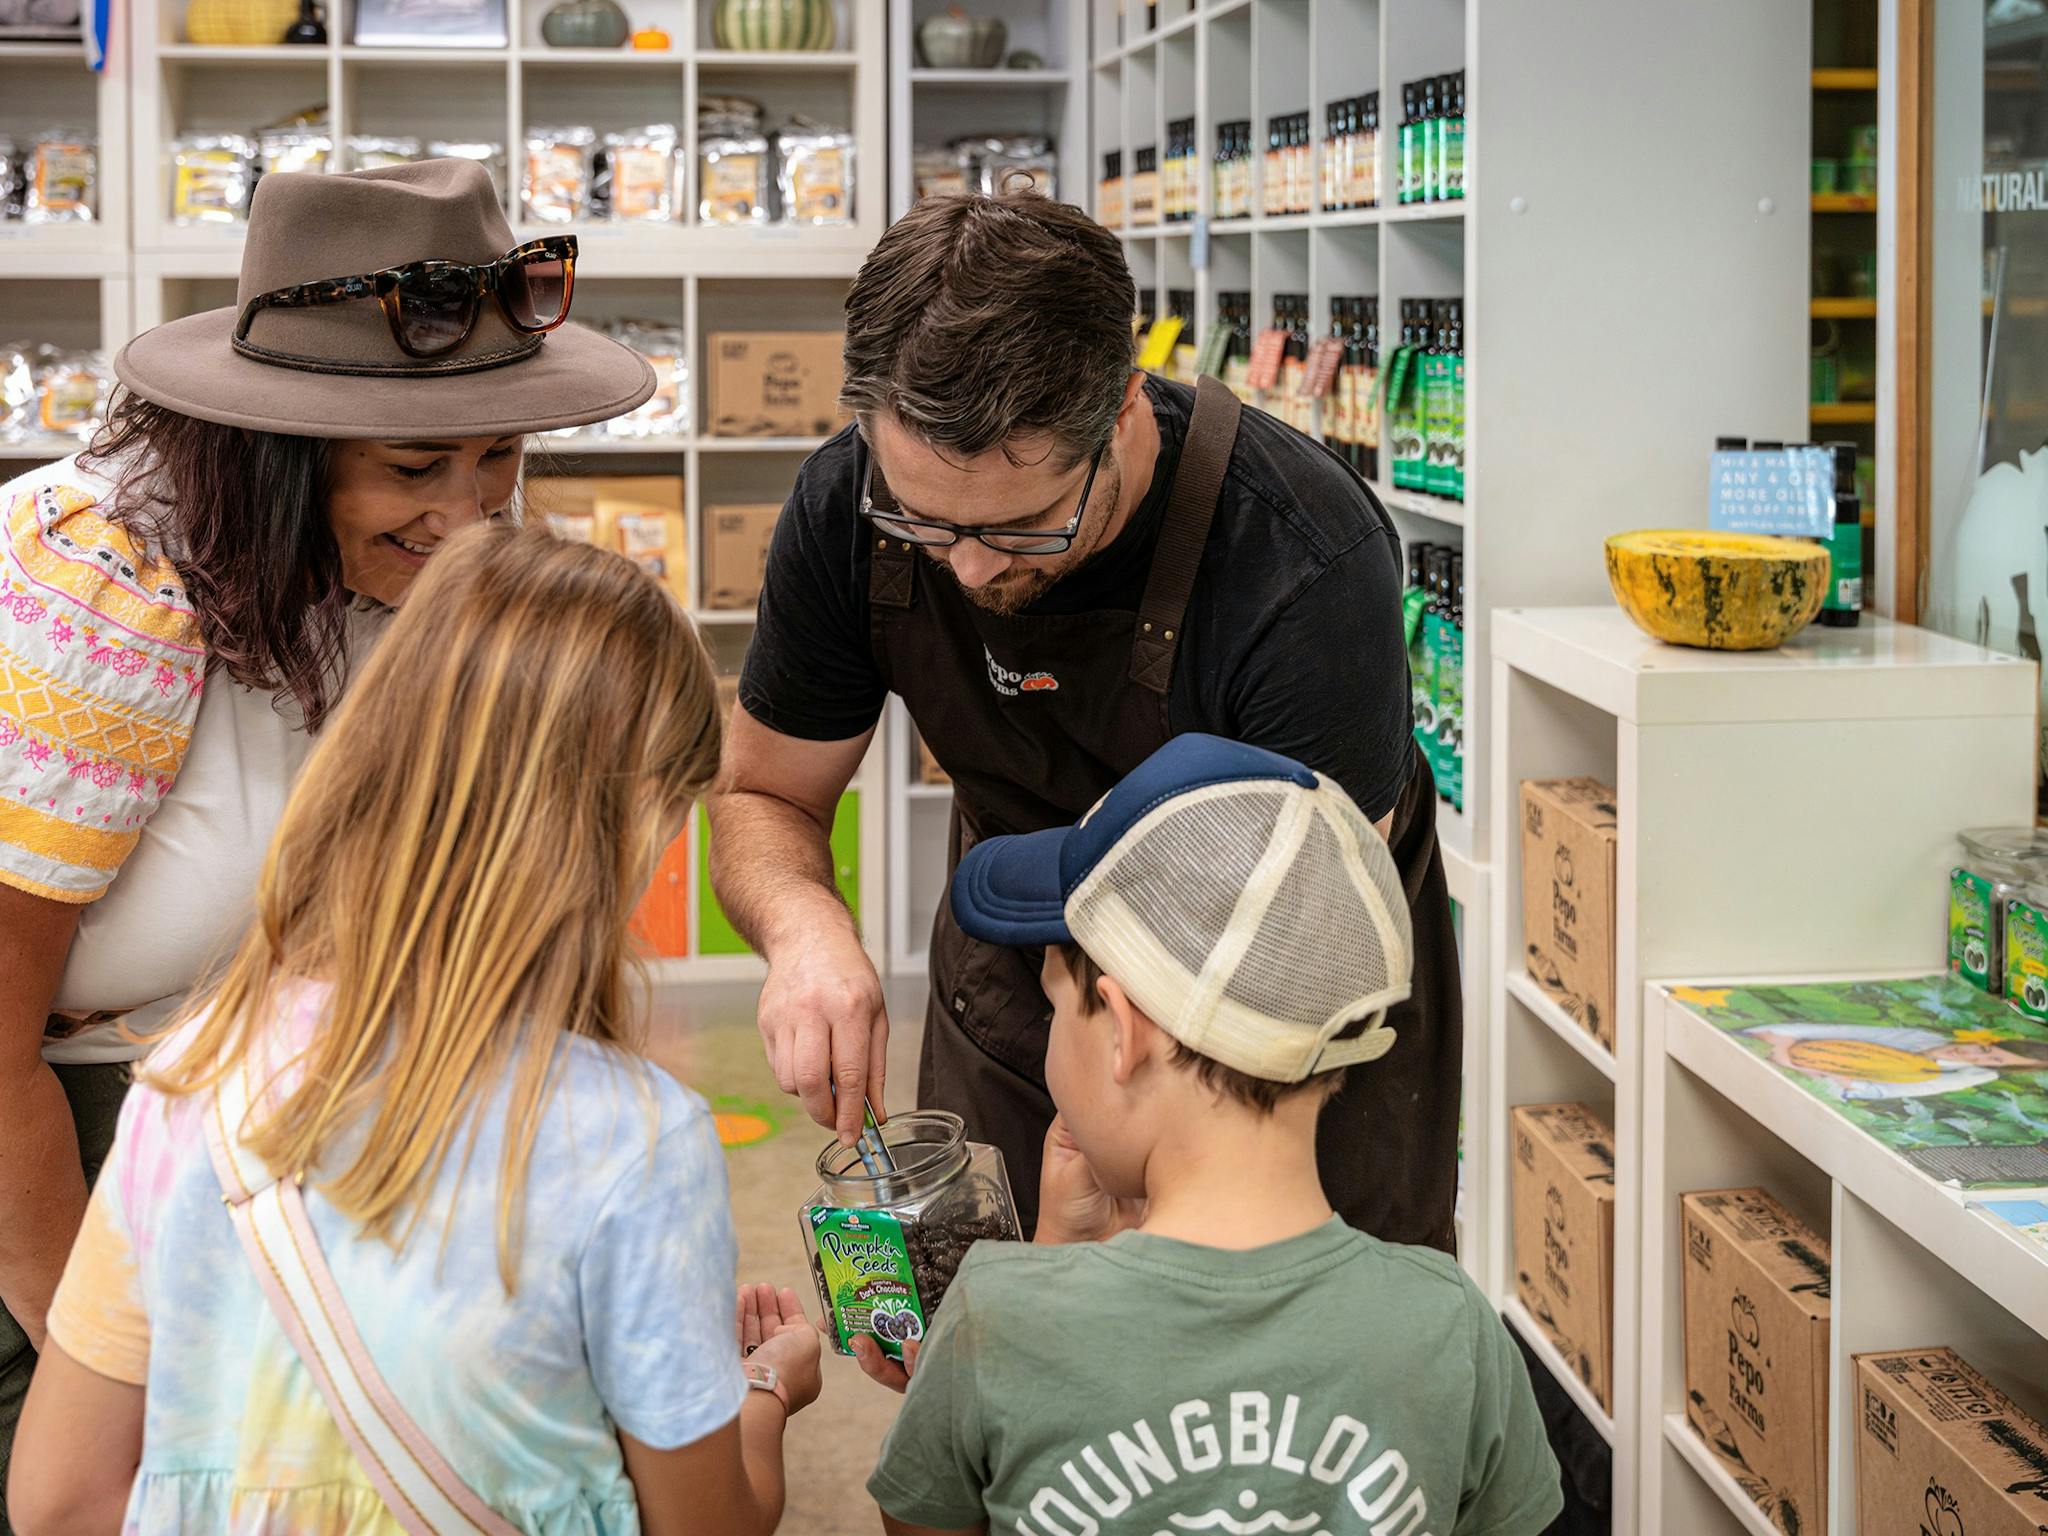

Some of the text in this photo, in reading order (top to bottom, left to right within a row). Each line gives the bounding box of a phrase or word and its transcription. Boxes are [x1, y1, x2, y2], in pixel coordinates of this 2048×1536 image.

[822, 1231, 903, 1264] Pumpkin
[851, 1254, 898, 1277] Seeds
[1727, 1329, 1764, 1395] Pepo
[1728, 1372, 1765, 1432] Farms
[1015, 1391, 1434, 1536] OUNGBLOOD
